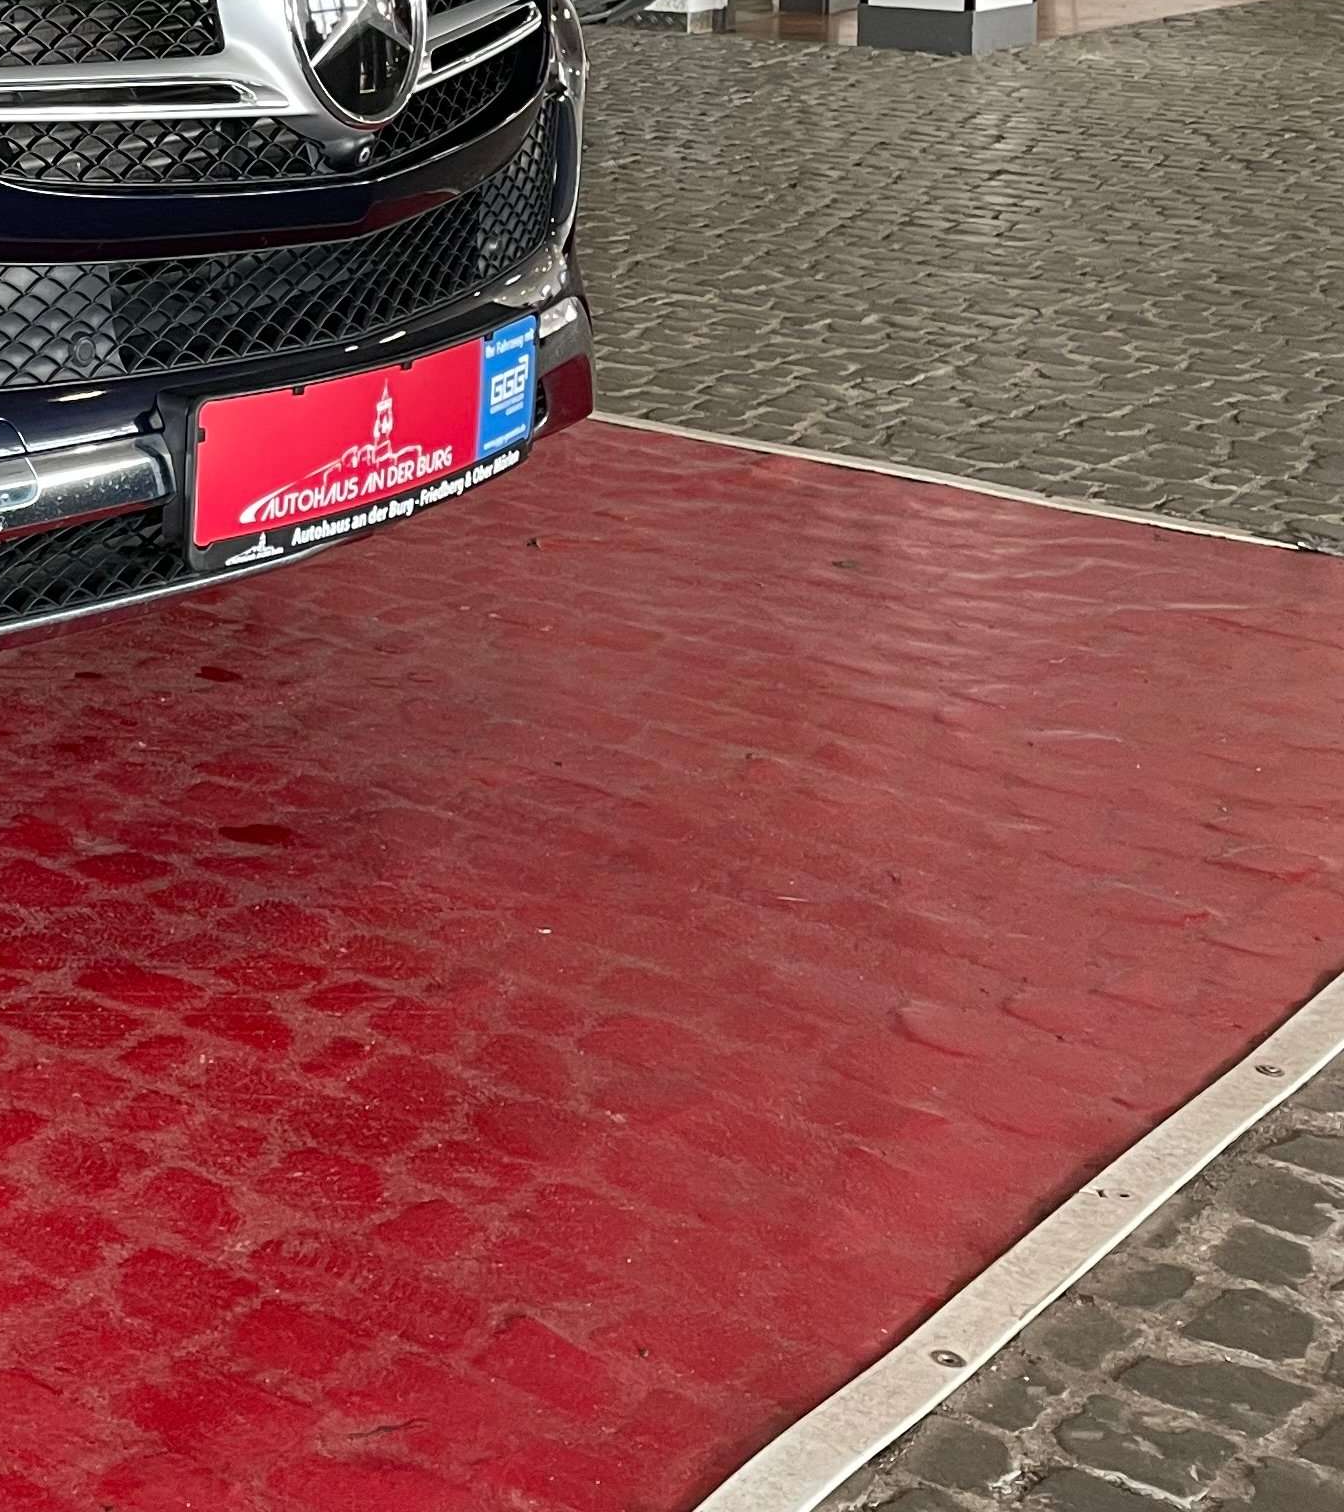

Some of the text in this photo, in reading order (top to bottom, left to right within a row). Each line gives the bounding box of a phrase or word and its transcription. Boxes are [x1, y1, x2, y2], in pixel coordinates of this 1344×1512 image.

[260, 445, 453, 522] AUTOHAUS AN DER BURG
[291, 517, 351, 546] Autohaus
[351, 512, 367, 530] an
[368, 504, 389, 525] der
[388, 497, 414, 516] Burg
